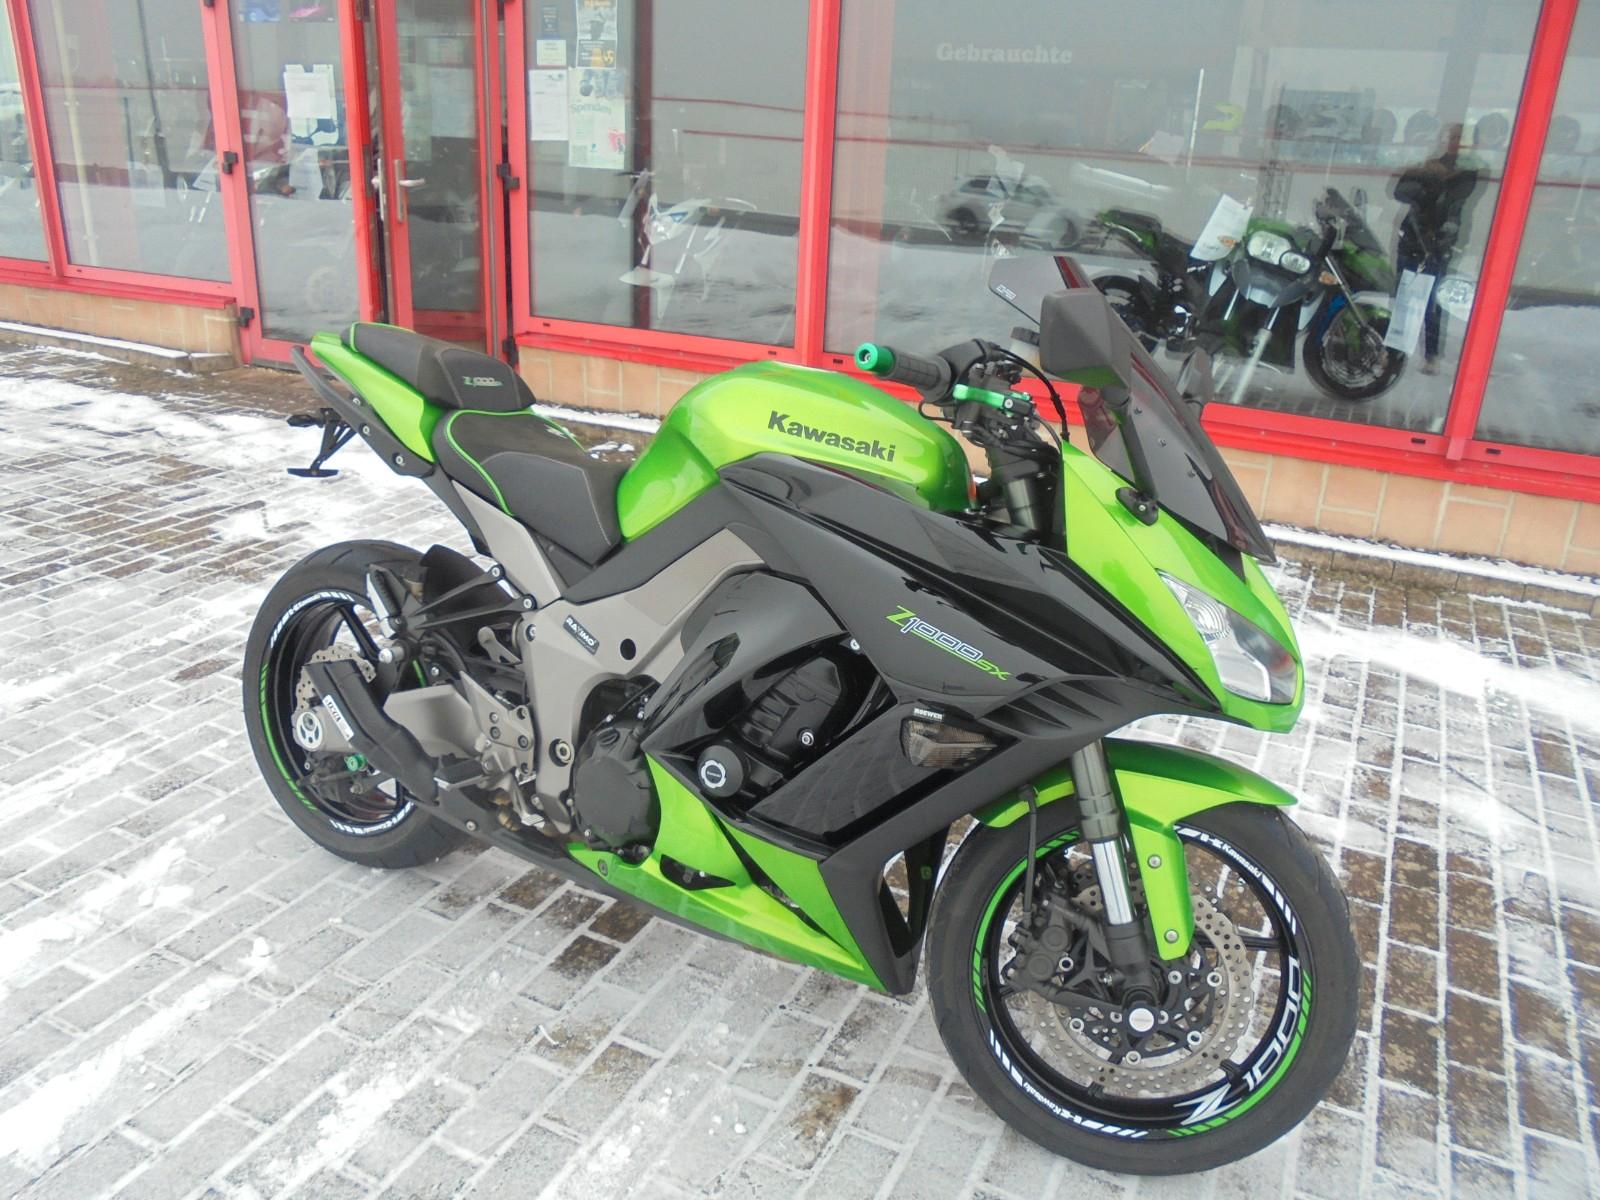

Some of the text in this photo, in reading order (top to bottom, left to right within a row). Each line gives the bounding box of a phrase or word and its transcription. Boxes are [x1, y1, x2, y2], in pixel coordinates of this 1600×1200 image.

[935, 41, 1073, 64] Gebrauchte
[767, 410, 897, 462] Kawasaki
[885, 605, 1013, 681] Z1000SX
[1222, 842, 1263, 878] Kawasaki
[1023, 1082, 1062, 1115] Kawasaki
